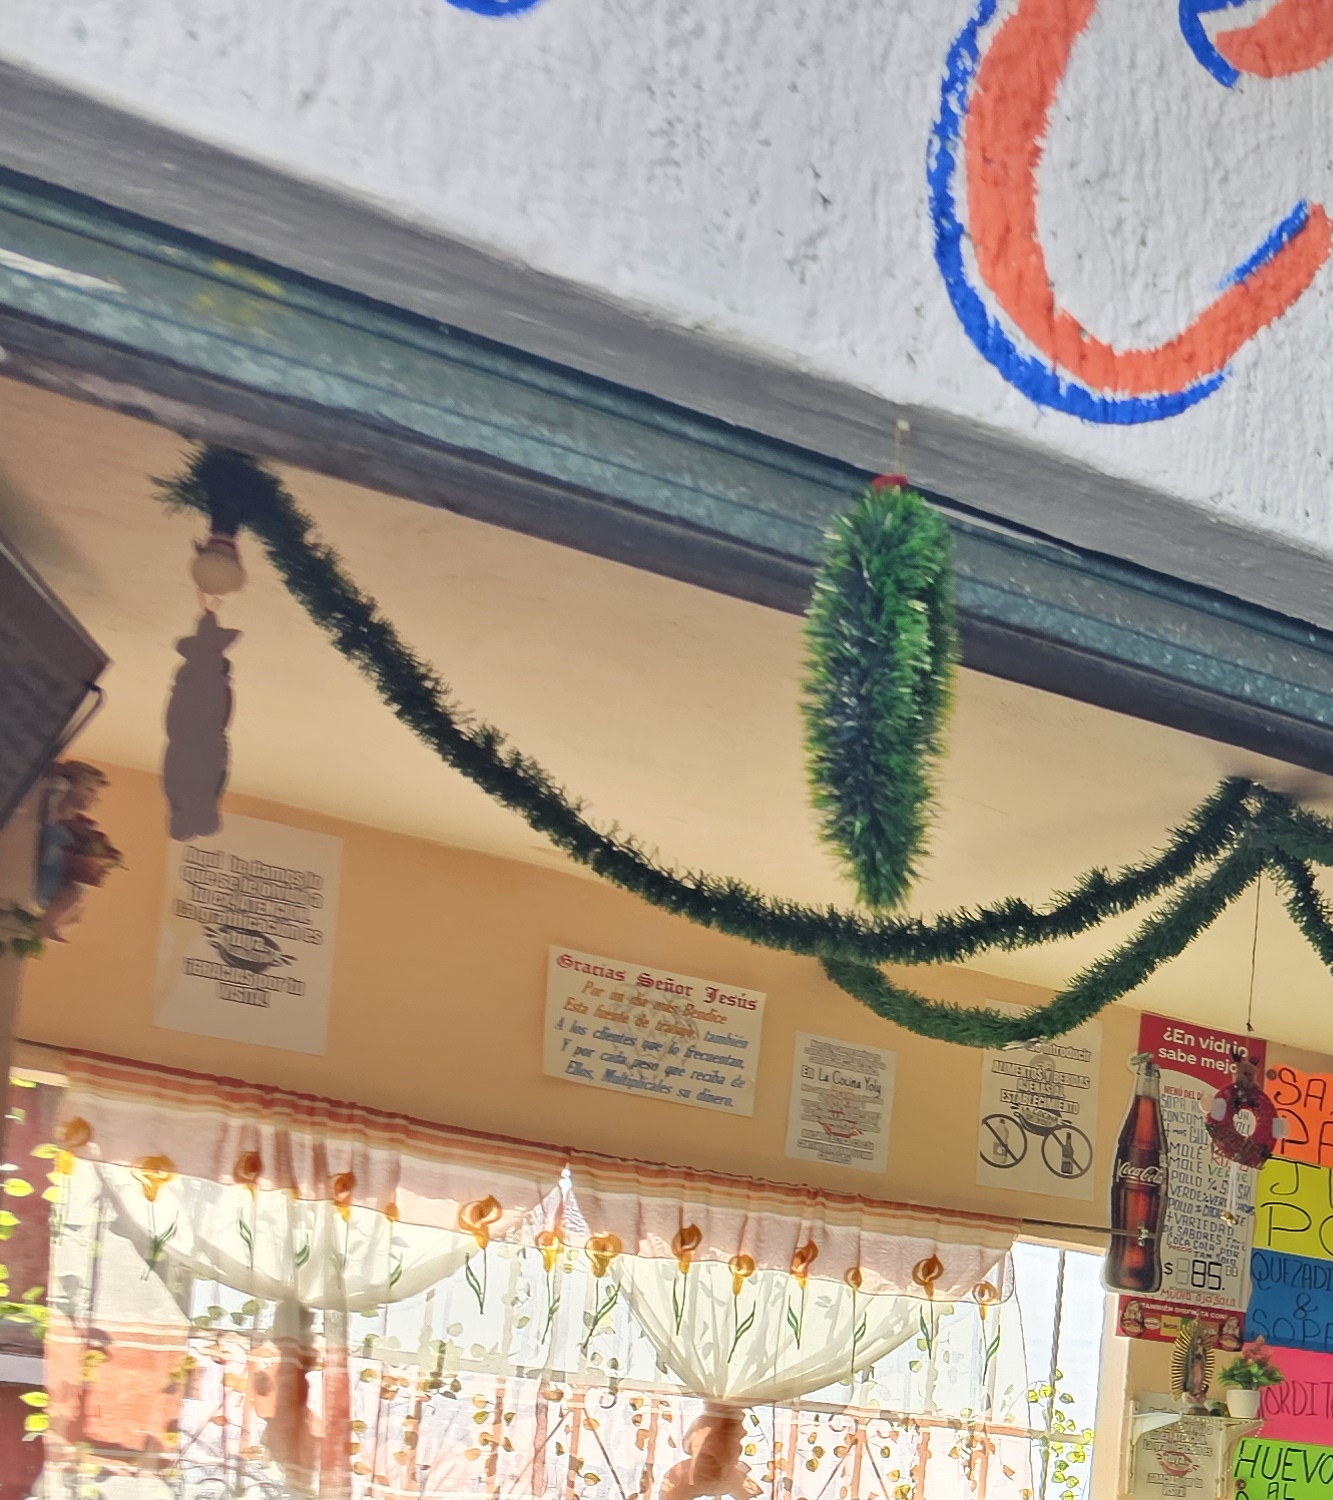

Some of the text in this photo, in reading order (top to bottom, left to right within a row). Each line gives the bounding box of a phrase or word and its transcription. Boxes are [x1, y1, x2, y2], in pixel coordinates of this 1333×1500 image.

[557, 953, 758, 1010] Gracias Señor Jesús
[581, 980, 605, 997] Por
[592, 1026, 637, 1047] clientes
[1162, 1026, 1195, 1048] ¿En
[1158, 1045, 1238, 1074] sabe mejo
[1169, 1142, 1203, 1160] MOLE
[1169, 1156, 1203, 1173] MOLE
[1171, 1170, 1203, 1187] POLLO
[1166, 1234, 1190, 1248] COCA
[1193, 1241, 1215, 1251] COLA
[1177, 1226, 1222, 1245] SABORES
[1292, 1292, 1318, 1320] &
[1266, 1483, 1296, 1500] AL
